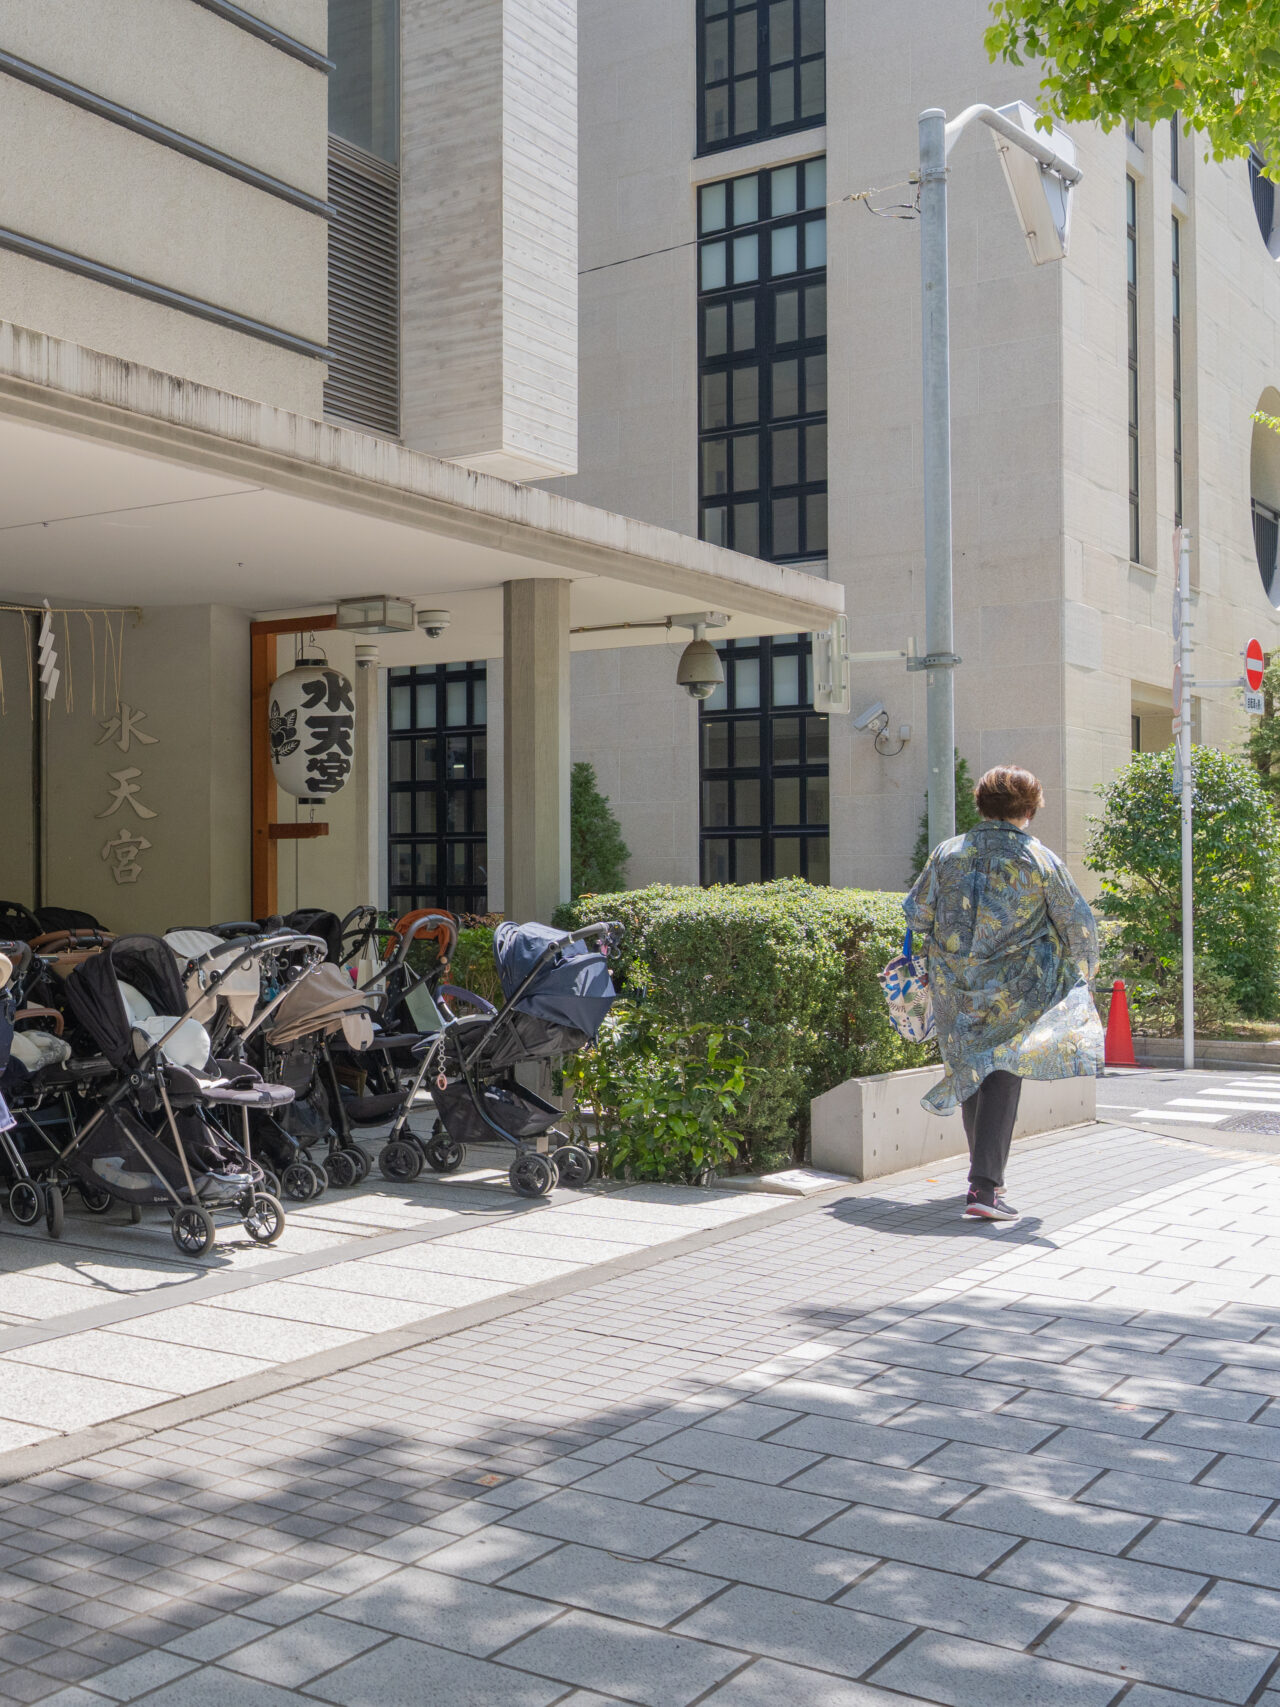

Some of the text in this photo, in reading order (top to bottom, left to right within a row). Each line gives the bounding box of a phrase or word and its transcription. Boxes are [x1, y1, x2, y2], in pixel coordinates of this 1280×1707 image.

[95, 702, 160, 885] 水天宮
[300, 671, 355, 794] 水天宮
